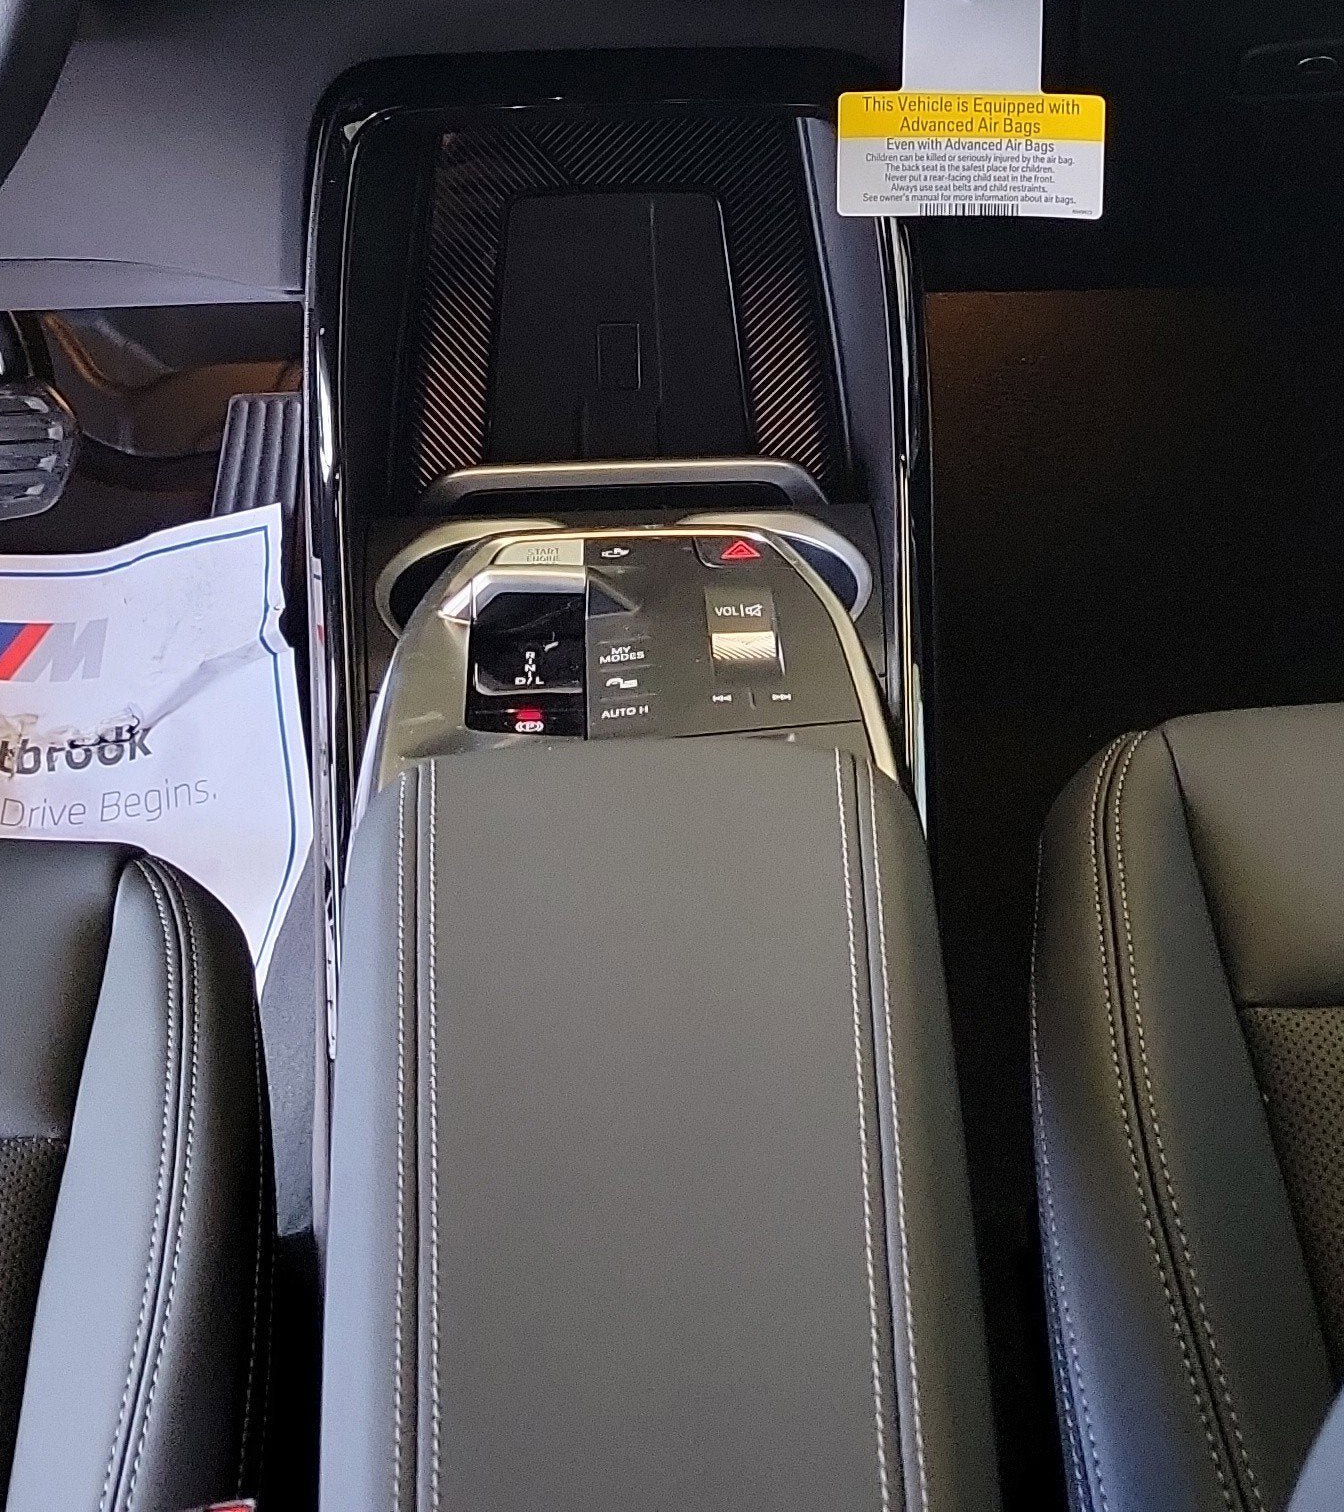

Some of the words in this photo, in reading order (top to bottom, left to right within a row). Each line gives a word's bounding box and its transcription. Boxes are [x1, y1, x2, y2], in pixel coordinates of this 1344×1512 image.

[862, 96, 894, 112] This
[897, 96, 953, 113] Vehicle
[957, 96, 968, 113] is
[973, 97, 1045, 116] Equipped
[1049, 99, 1080, 115] with
[899, 116, 974, 132] Advanced
[978, 117, 999, 133] Air
[1003, 117, 1041, 137] Bags
[886, 138, 919, 150] Even
[921, 138, 942, 150] with
[944, 138, 1003, 151] Advanced
[1005, 139, 1022, 151] Air
[1024, 139, 1055, 154] Bags
[865, 152, 898, 162] Children
[899, 154, 913, 162] can
[914, 152, 925, 162] be
[926, 153, 947, 162] killed
[947, 154, 956, 162] or
[957, 153, 992, 164] seriously
[993, 154, 1020, 164] injured
[1021, 155, 1031, 165] by
[1032, 155, 1045, 163] the
[1046, 155, 1057, 164] air
[1058, 156, 1075, 166] bag.
[885, 163, 900, 172] The
[901, 163, 920, 172] back
[921, 164, 938, 172] seat
[939, 163, 946, 172] is
[947, 163, 960, 172] the
[962, 163, 985, 172] safest
[986, 164, 1008, 173] place
[1008, 164, 1020, 172] for
[1020, 164, 1055, 174] children.
[884, 173, 907, 182] Never
[908, 174, 922, 183] put
[929, 173, 972, 183] rear-facing
[972, 174, 992, 182] child
[993, 174, 1010, 182] seat
[1011, 174, 1019, 182] in
[1019, 174, 1033, 183] the
[1033, 175, 1055, 184] front.
[891, 183, 918, 193] Always
[952, 183, 972, 192] belts
[972, 183, 988, 192] and
[988, 183, 1008, 192] child
[1009, 184, 1048, 193] restraints.
[862, 193, 879, 202] See
[879, 193, 910, 202] owner's
[911, 193, 940, 201] manual
[940, 193, 952, 201] for
[952, 194, 973, 202] more
[974, 193, 1019, 202] information
[1019, 194, 1043, 203] about
[1043, 195, 1054, 203] air
[1055, 195, 1076, 205] bags.
[714, 605, 740, 617] VOL
[611, 646, 631, 655] MY
[599, 651, 645, 664] MODES
[601, 707, 637, 719] AUTO
[639, 705, 649, 715] H
[0, 798, 87, 827] Drive
[100, 778, 217, 822] Begins.
